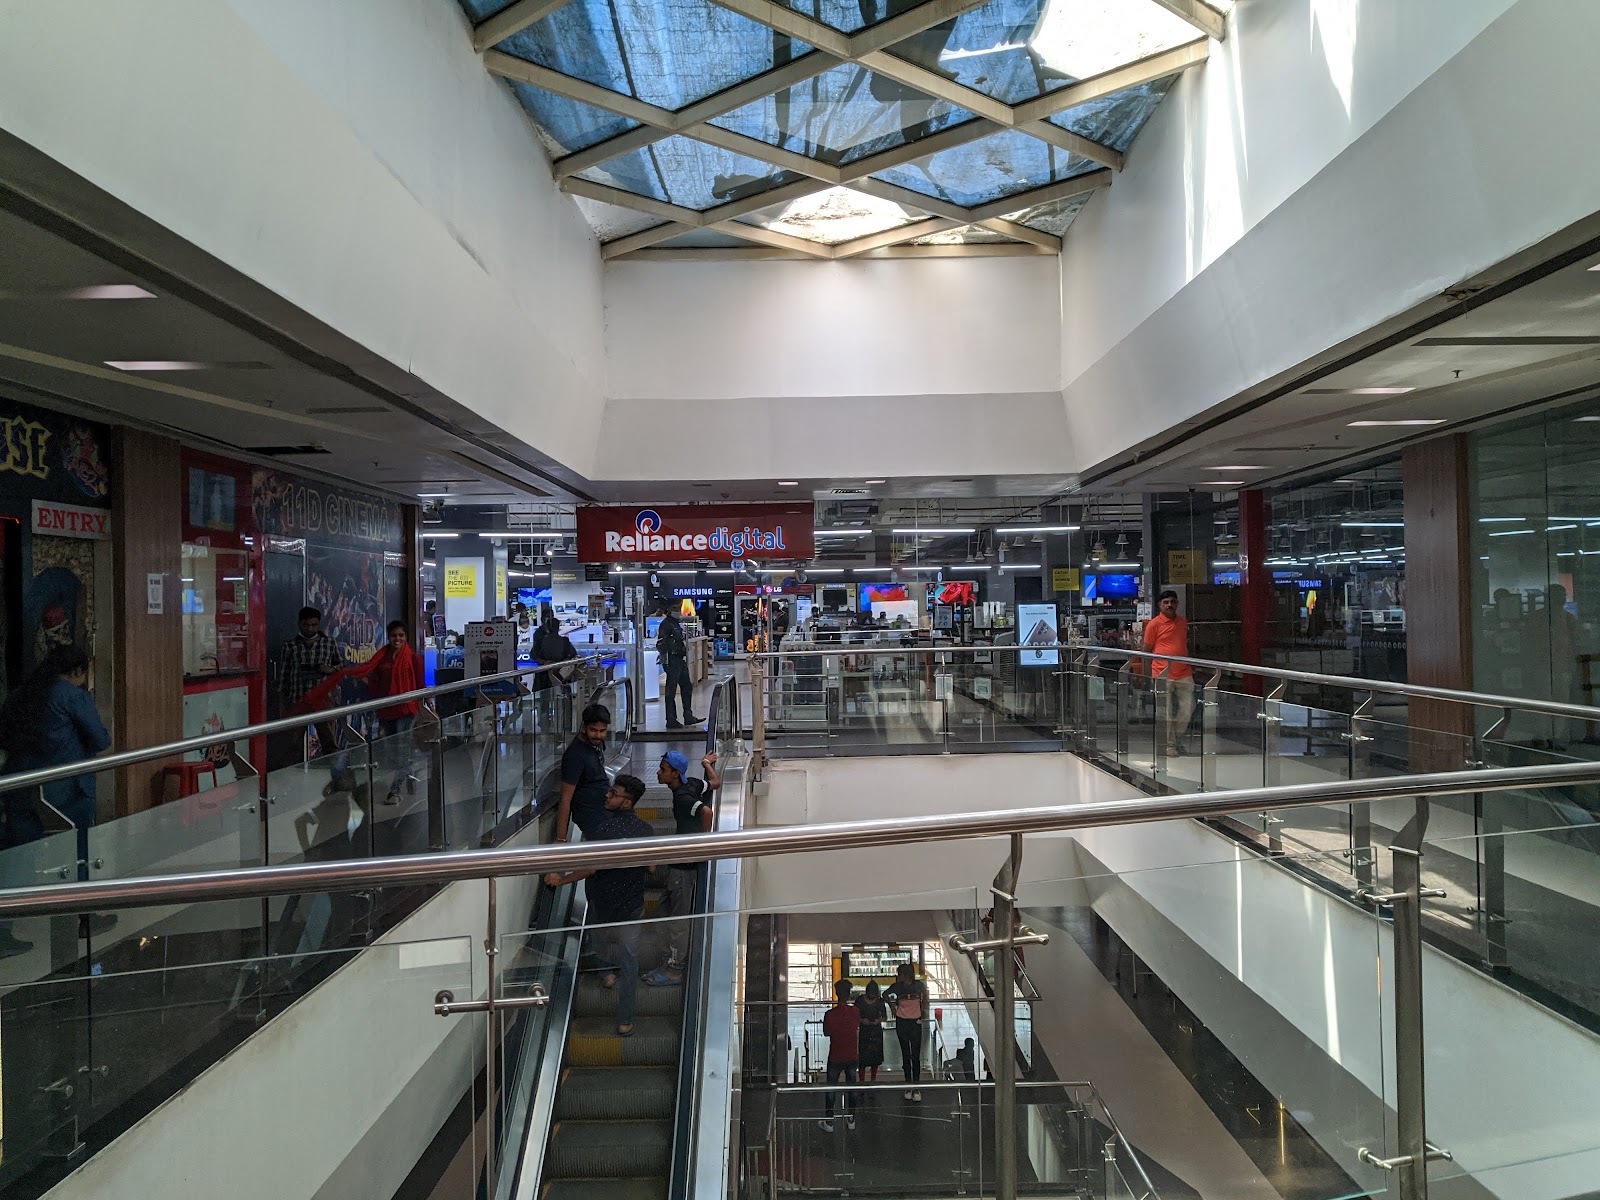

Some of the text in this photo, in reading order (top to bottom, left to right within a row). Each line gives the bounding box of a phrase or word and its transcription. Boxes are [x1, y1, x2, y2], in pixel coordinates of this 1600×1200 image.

[37, 507, 107, 534] ENTRY
[282, 483, 391, 543] 11D CINEMA
[673, 588, 713, 596] SAMSUNG
[448, 659, 464, 668] Jio
